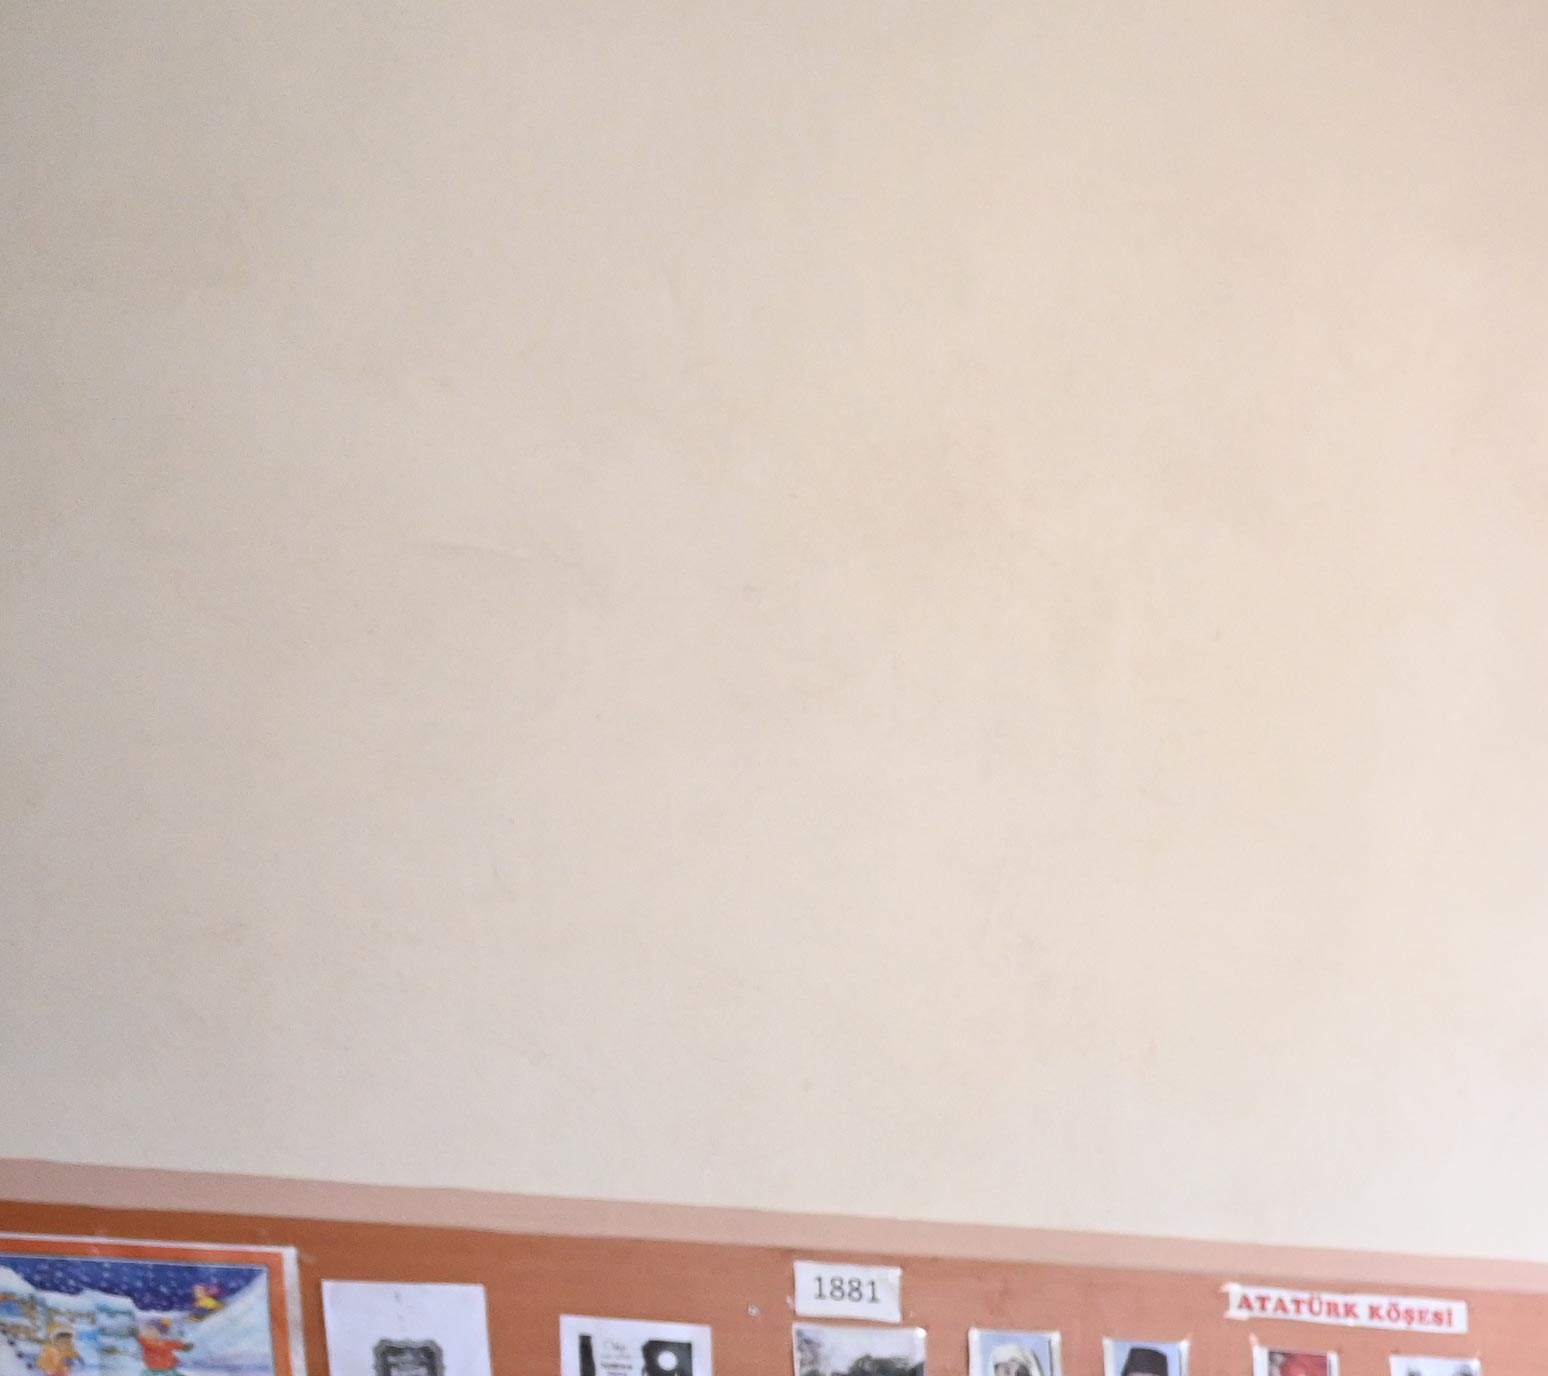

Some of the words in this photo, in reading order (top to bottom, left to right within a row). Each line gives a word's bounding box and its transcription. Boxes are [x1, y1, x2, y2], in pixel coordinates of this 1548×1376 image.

[812, 1276, 880, 1304] 1881
[1237, 1291, 1361, 1320] ATATÜRK
[1368, 1301, 1456, 1330] KÖŞESİ
